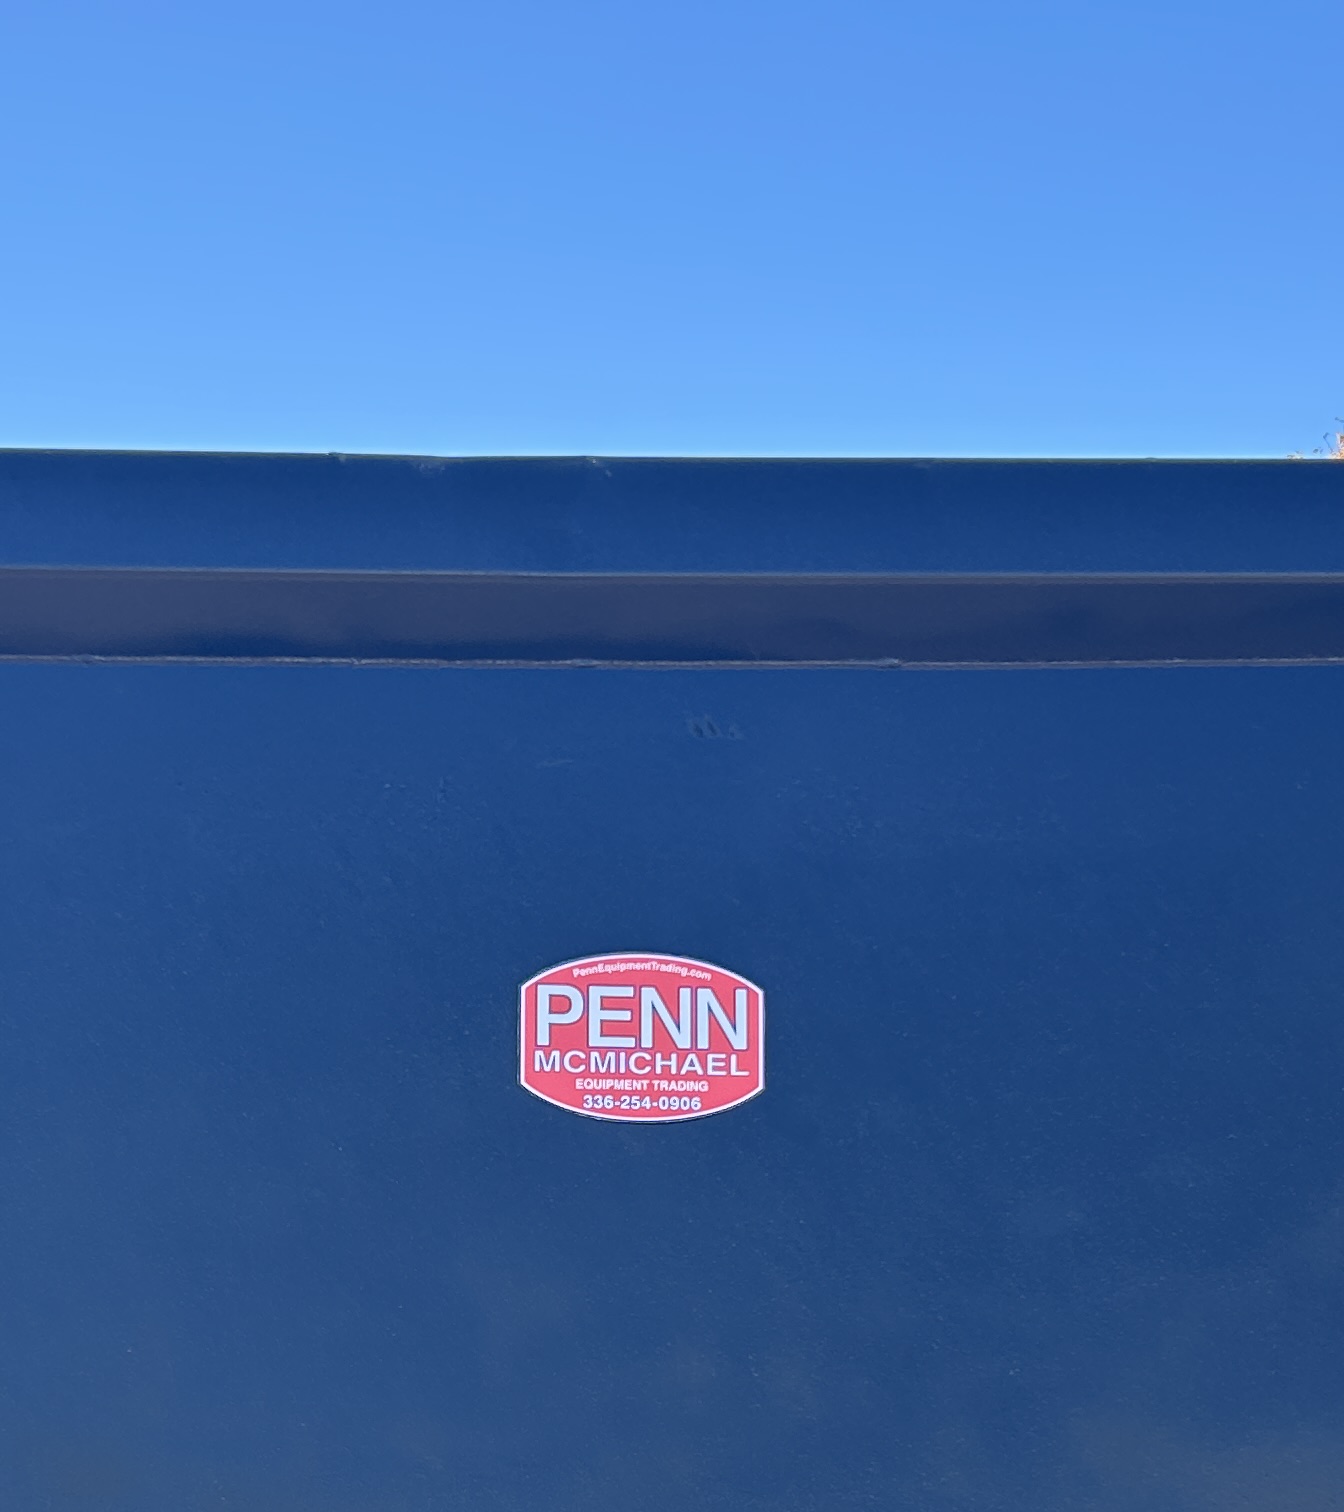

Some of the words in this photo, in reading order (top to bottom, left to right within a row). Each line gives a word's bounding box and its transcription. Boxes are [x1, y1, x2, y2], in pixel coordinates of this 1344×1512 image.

[572, 961, 711, 981] PennEquipmentTrading.com
[536, 984, 749, 1050] PENN
[534, 1050, 750, 1076] MCMICHAEL
[575, 1078, 649, 1091] EQUIPMENT
[652, 1079, 709, 1092] TRADING
[583, 1094, 702, 1111] 336-254-0906
